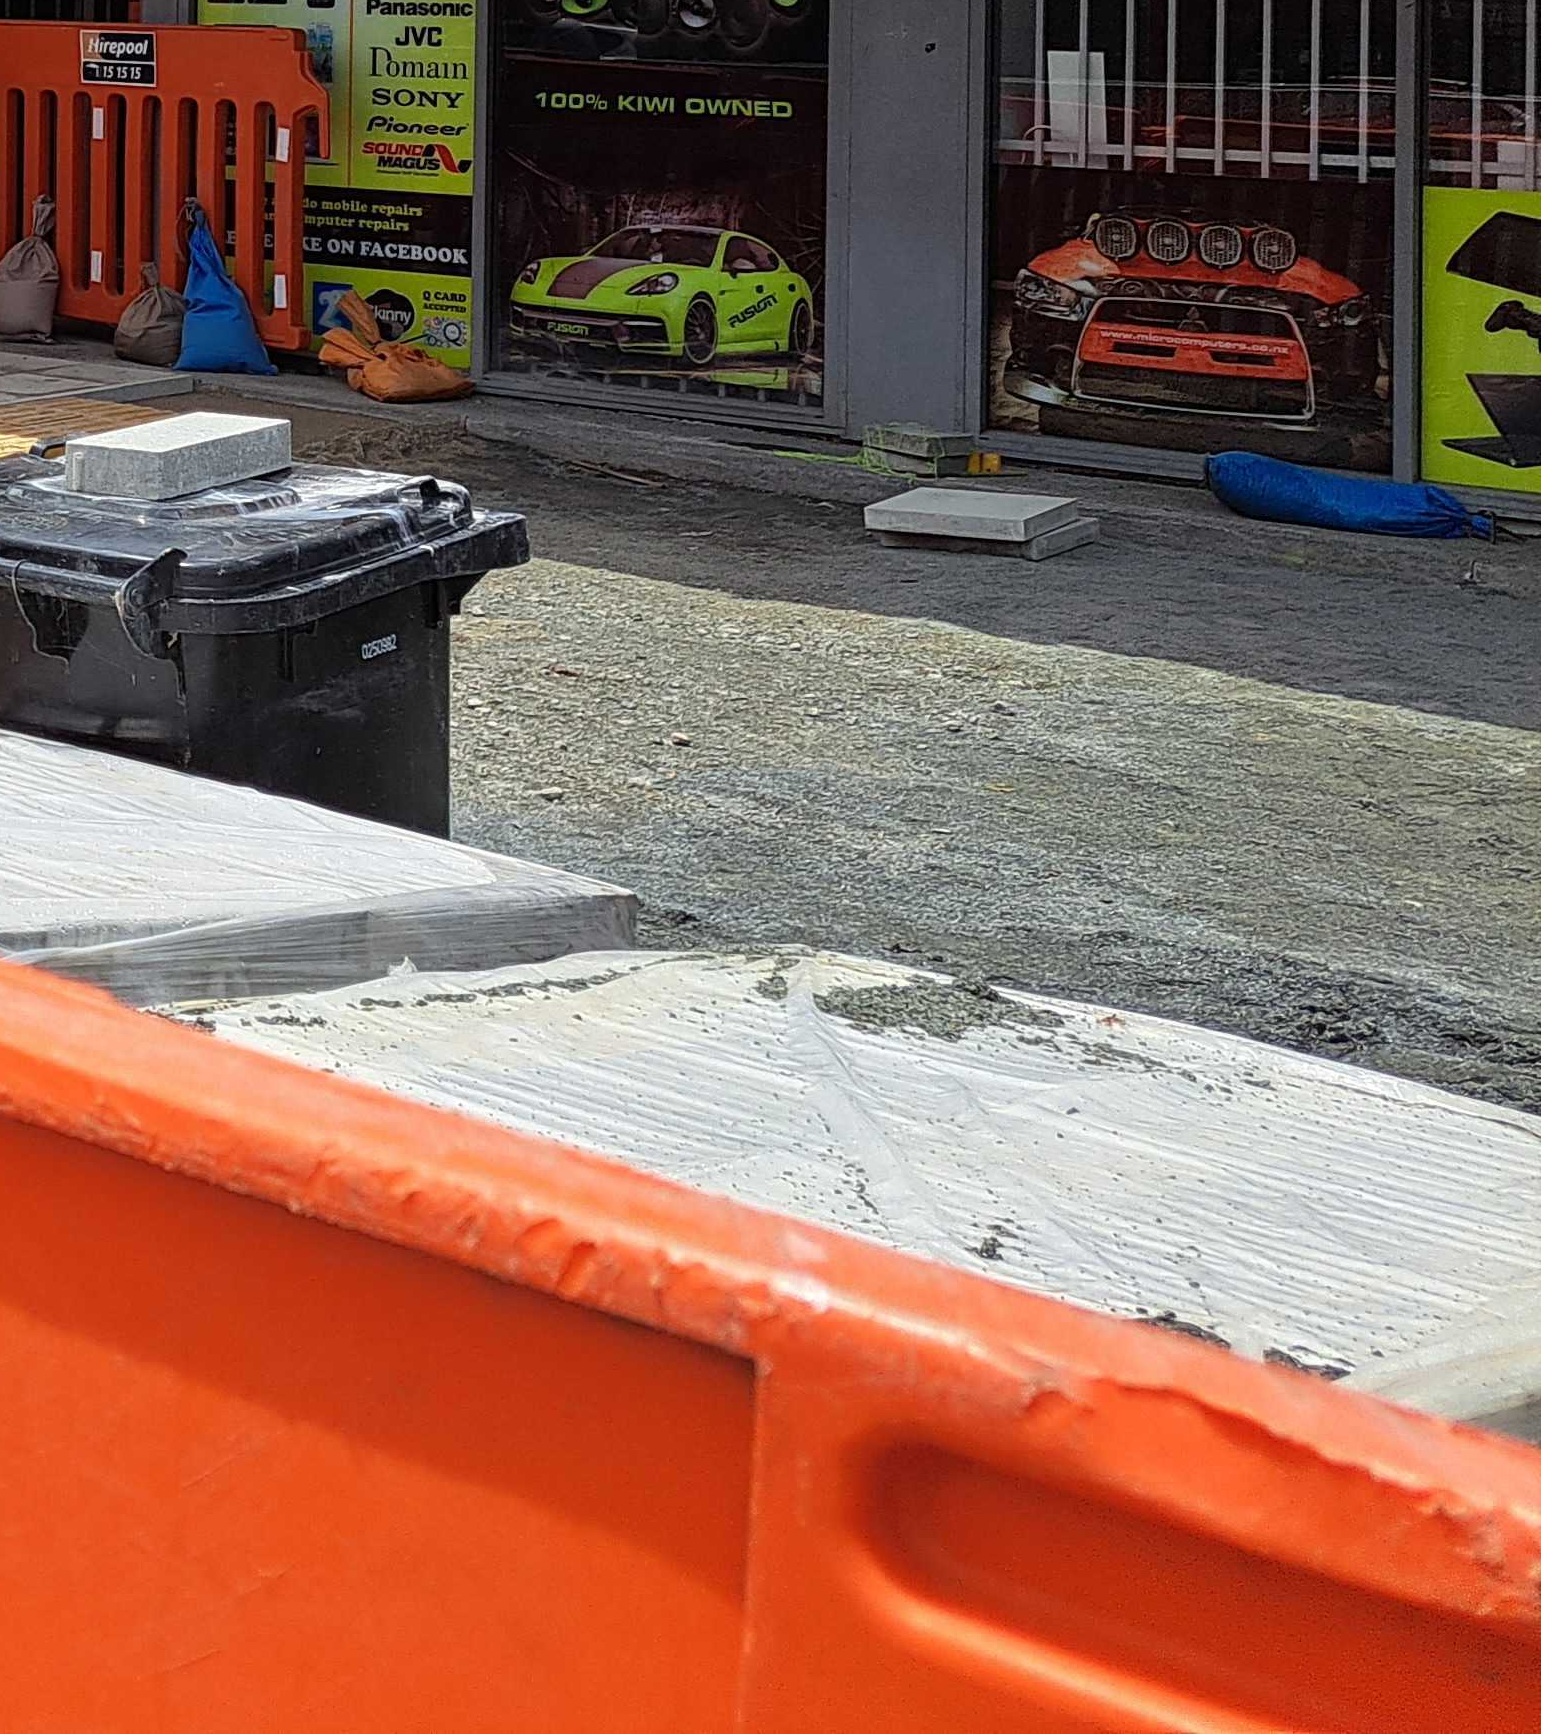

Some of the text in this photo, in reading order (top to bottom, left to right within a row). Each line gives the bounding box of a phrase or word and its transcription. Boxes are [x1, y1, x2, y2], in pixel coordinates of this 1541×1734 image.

[395, 26, 442, 46] JVC
[88, 37, 148, 58] Hirepool
[103, 66, 141, 79] 15 15 15
[369, 47, 469, 80] Domain
[372, 88, 464, 108] SONY
[534, 92, 793, 119] 100% KIWI OWNED
[367, 116, 467, 136] Pioneer
[362, 142, 425, 156] SOUND
[321, 200, 423, 217] mobile repairs
[358, 218, 409, 232] repairs
[327, 238, 354, 255] ON
[359, 241, 468, 265] FACEBOOK
[423, 291, 467, 303] Q CARD
[422, 303, 467, 313] ACCEPTED
[727, 294, 778, 329] FUSION
[546, 321, 590, 336] FUSION
[1100, 329, 1289, 355] www.microcomputers.co.nz
